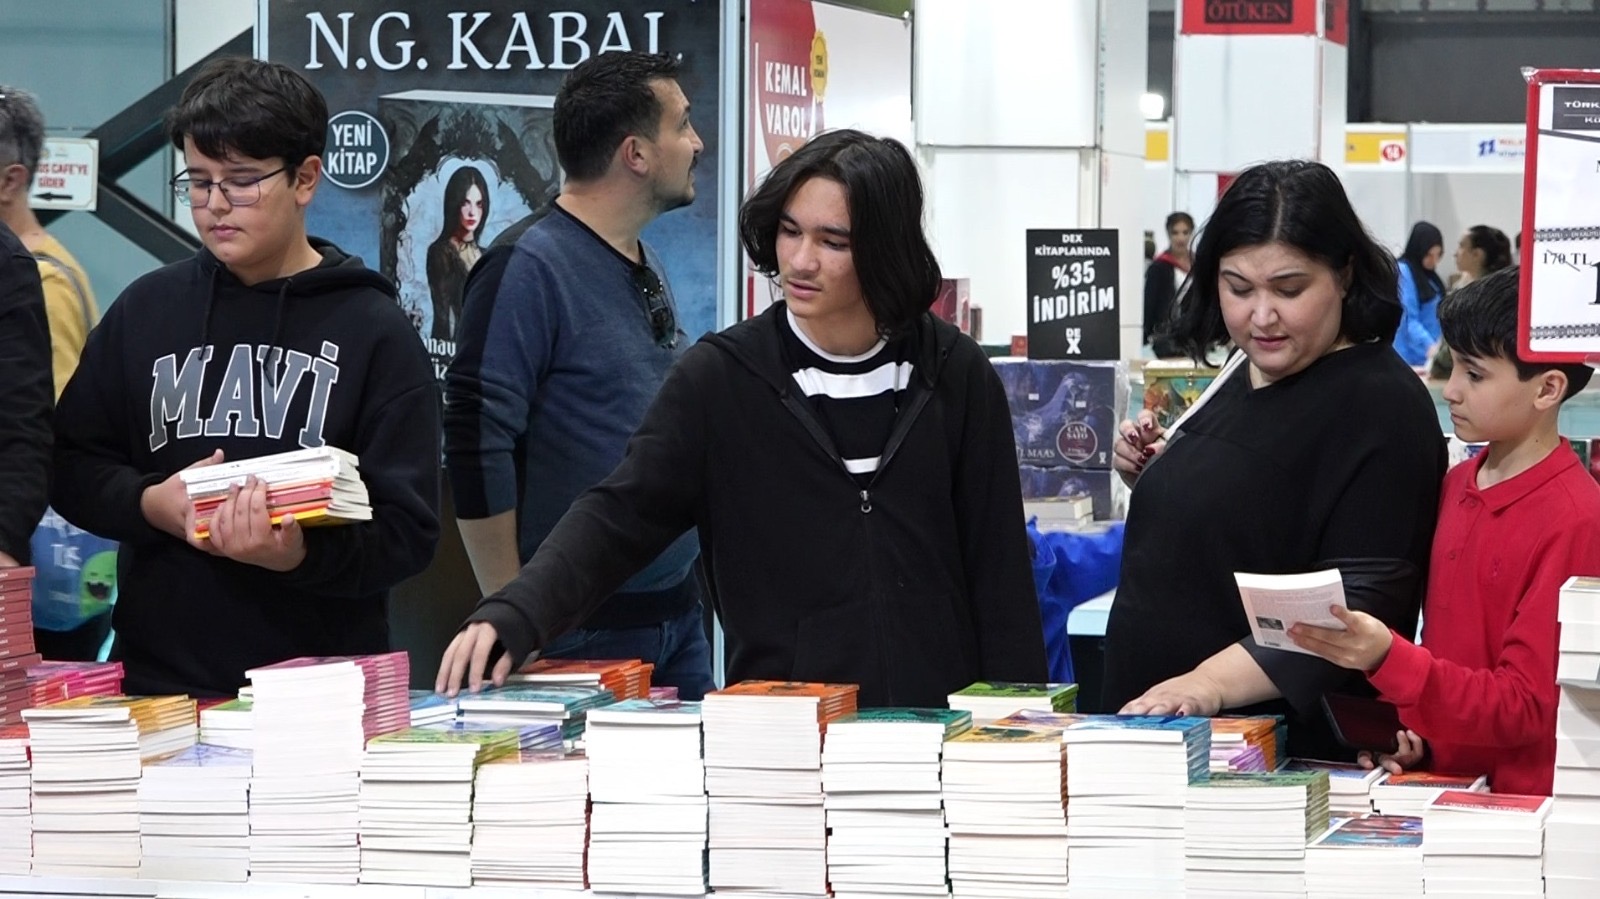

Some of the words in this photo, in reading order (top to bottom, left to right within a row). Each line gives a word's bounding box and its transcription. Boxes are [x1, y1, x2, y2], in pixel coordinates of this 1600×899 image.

[305, 12, 429, 70] N.G.
[765, 62, 807, 96] KEMAL
[332, 120, 372, 147] YENİ
[765, 104, 807, 138] VAROL
[328, 148, 377, 175] KİTAP
[1035, 245, 1111, 256] KİTAPLARINDA
[1062, 234, 1083, 244] DEX
[1570, 253, 1592, 266] TL
[1052, 260, 1095, 290] %35
[1034, 285, 1114, 323] İNDİRİM
[149, 341, 340, 452] MAVİ
